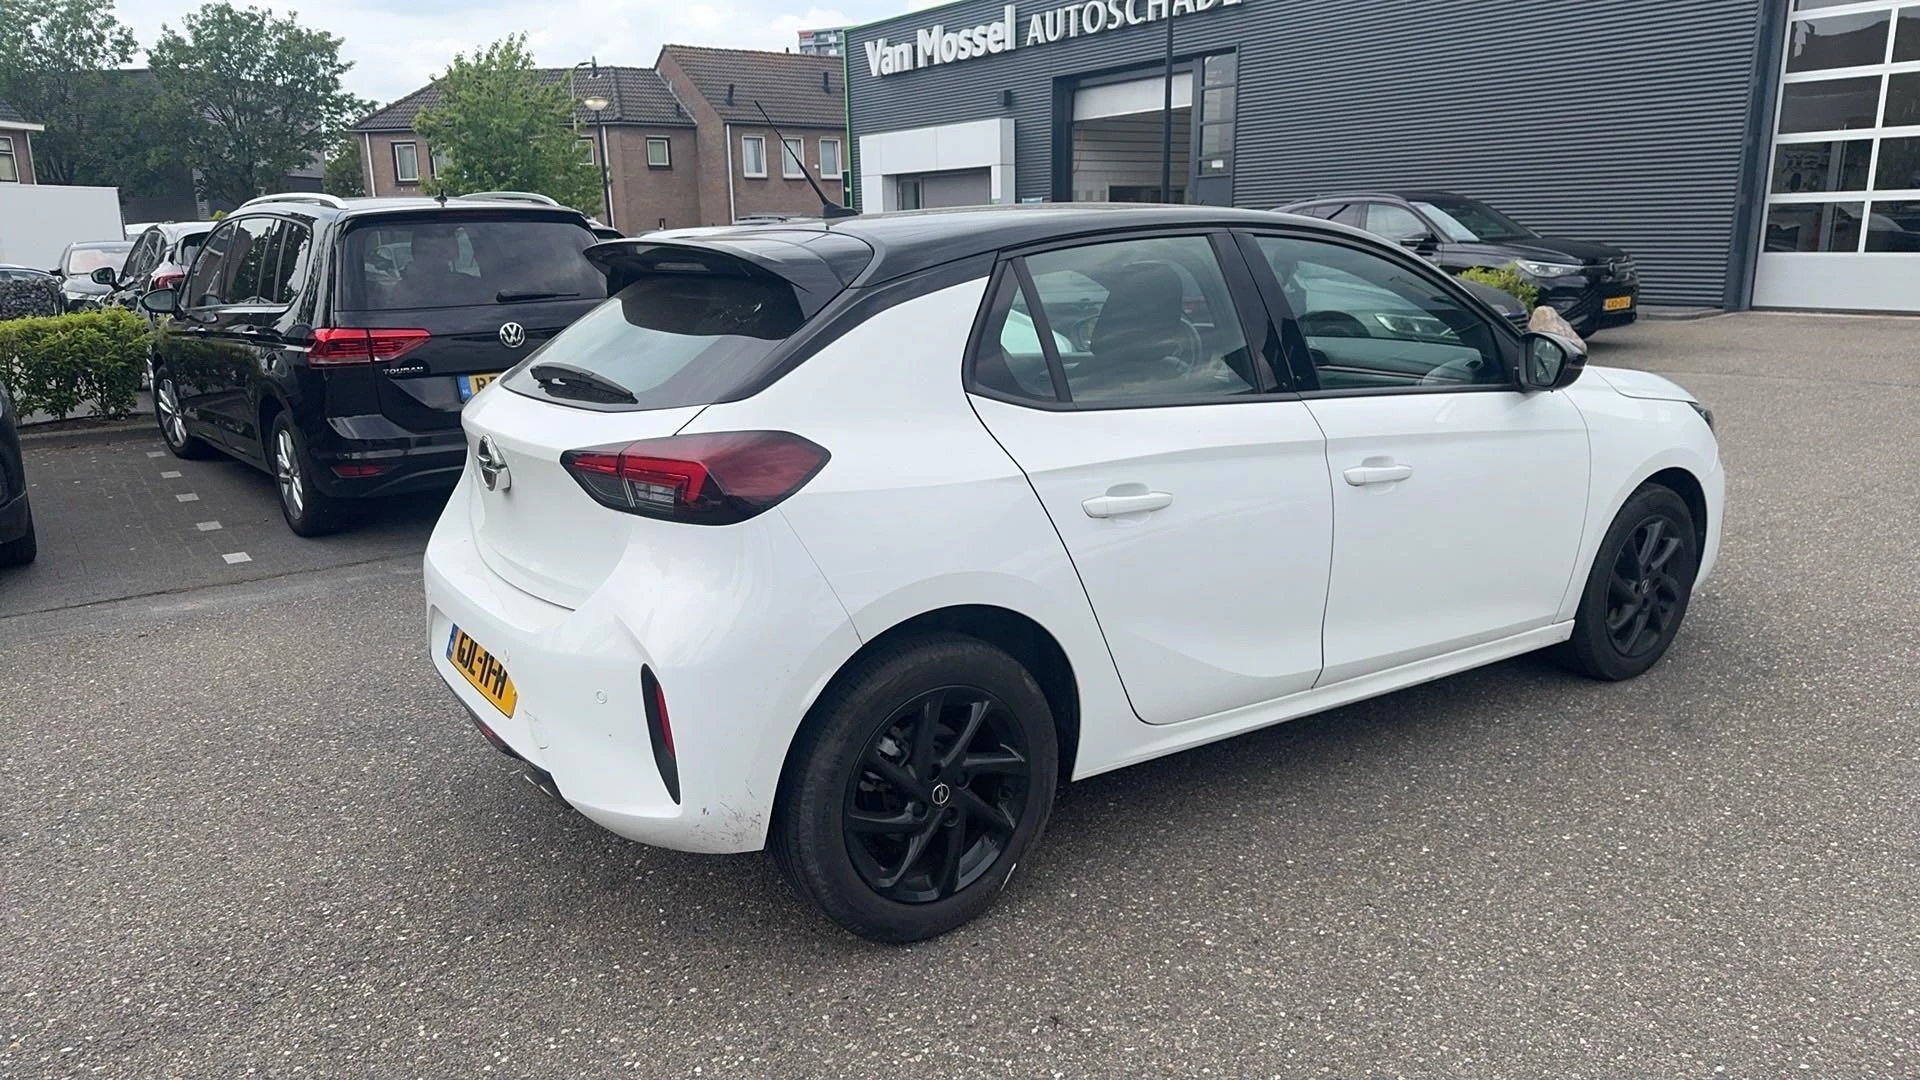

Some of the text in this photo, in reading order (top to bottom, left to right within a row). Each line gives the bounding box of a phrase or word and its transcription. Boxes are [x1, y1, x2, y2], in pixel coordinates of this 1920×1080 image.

[864, 0, 1241, 77] Van Mossel AUTOSCHA
[382, 366, 424, 375] TOURAN
